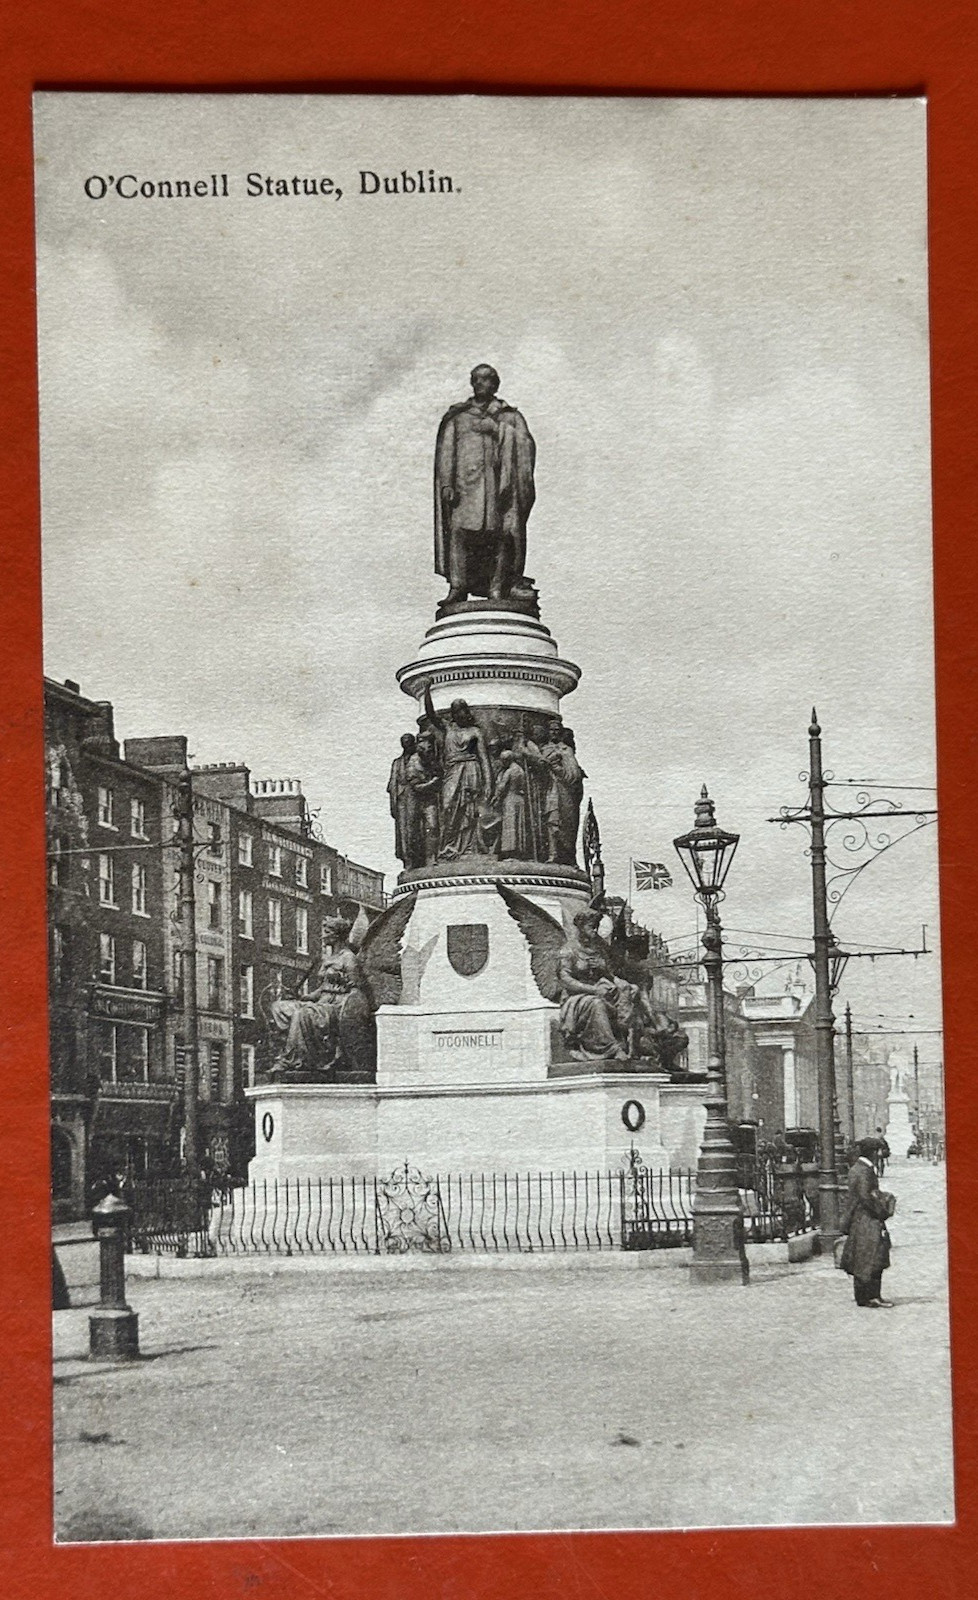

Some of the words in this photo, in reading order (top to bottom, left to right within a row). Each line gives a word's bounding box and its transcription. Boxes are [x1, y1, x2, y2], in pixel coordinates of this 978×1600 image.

[84, 174, 229, 200] O'Connell
[246, 172, 343, 201] Statue,
[359, 170, 463, 195] Dublin.
